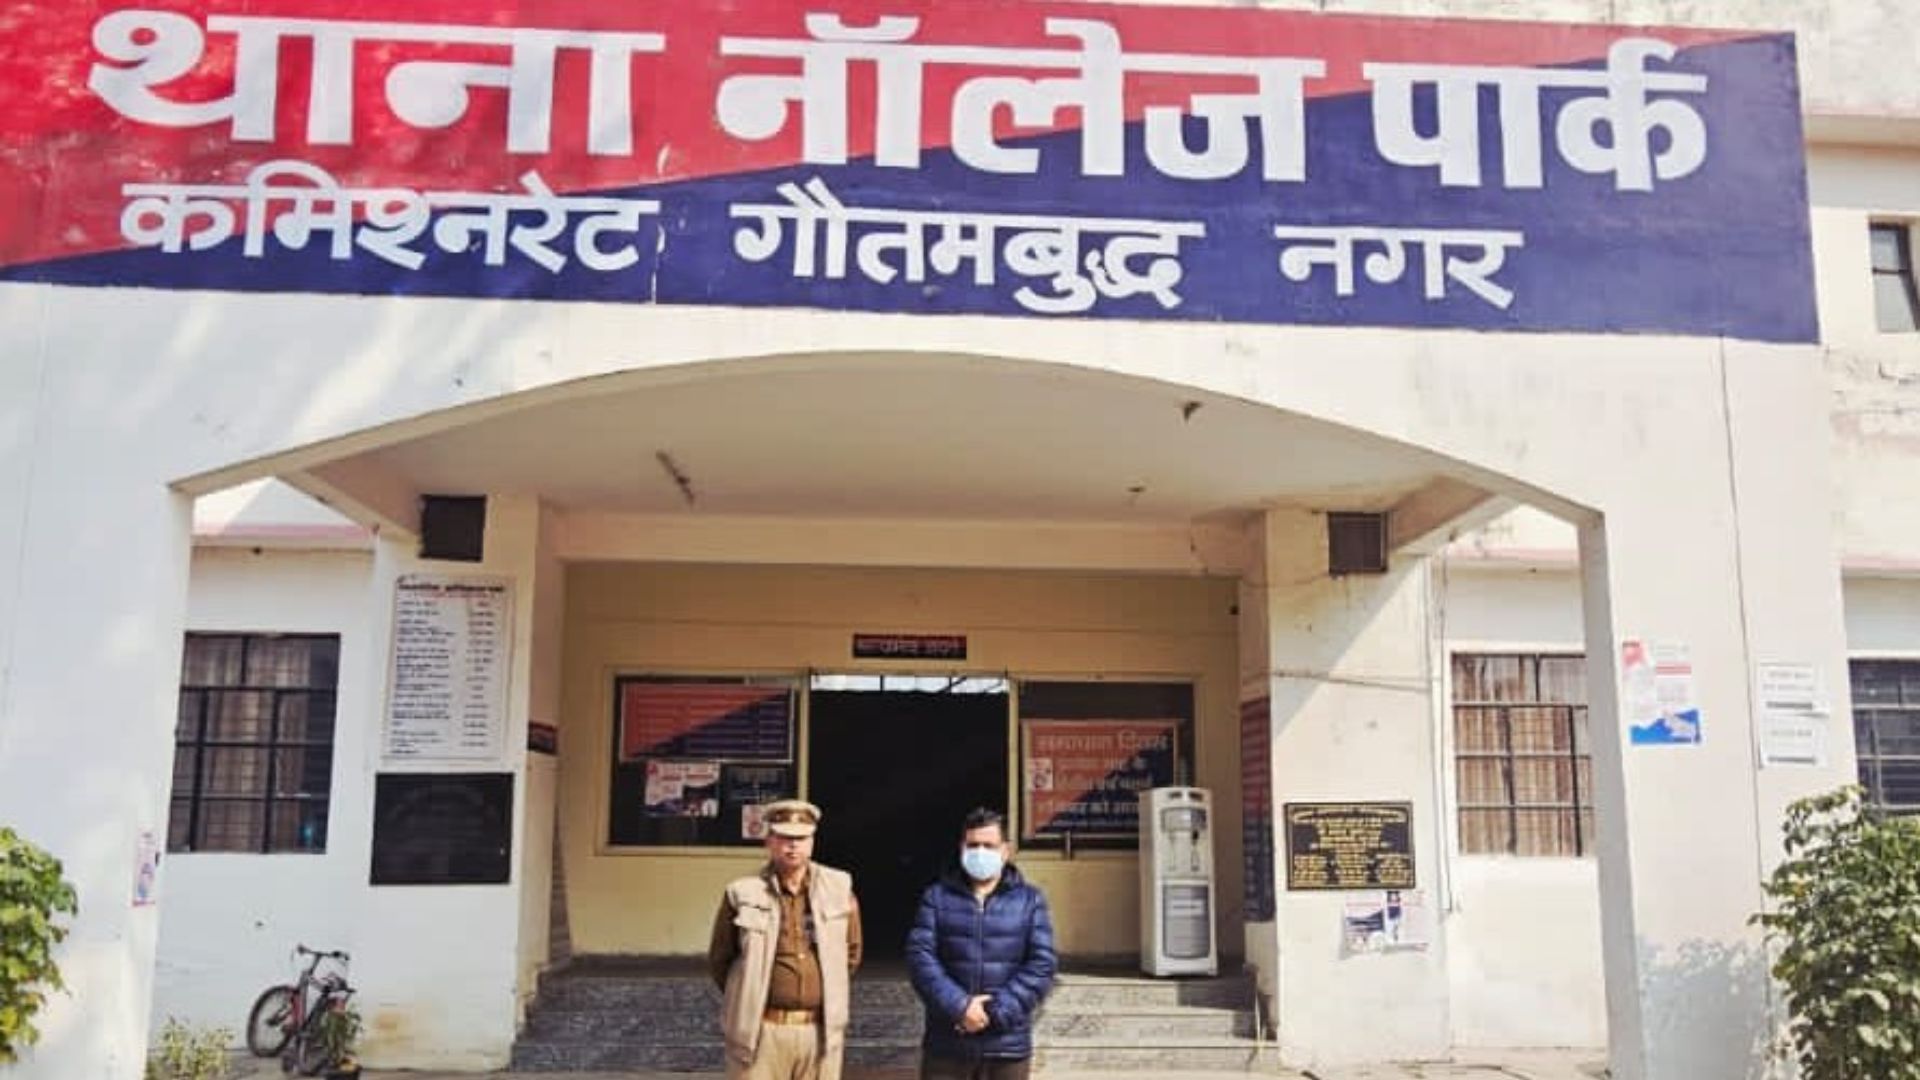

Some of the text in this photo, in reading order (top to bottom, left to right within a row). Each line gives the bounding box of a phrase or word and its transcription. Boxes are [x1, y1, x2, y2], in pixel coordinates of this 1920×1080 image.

[90, 11, 1707, 190] थाना नॉलेज पार्क
[121, 161, 1523, 312] कमिश्नरेट गौतमबुद्ध नगर
